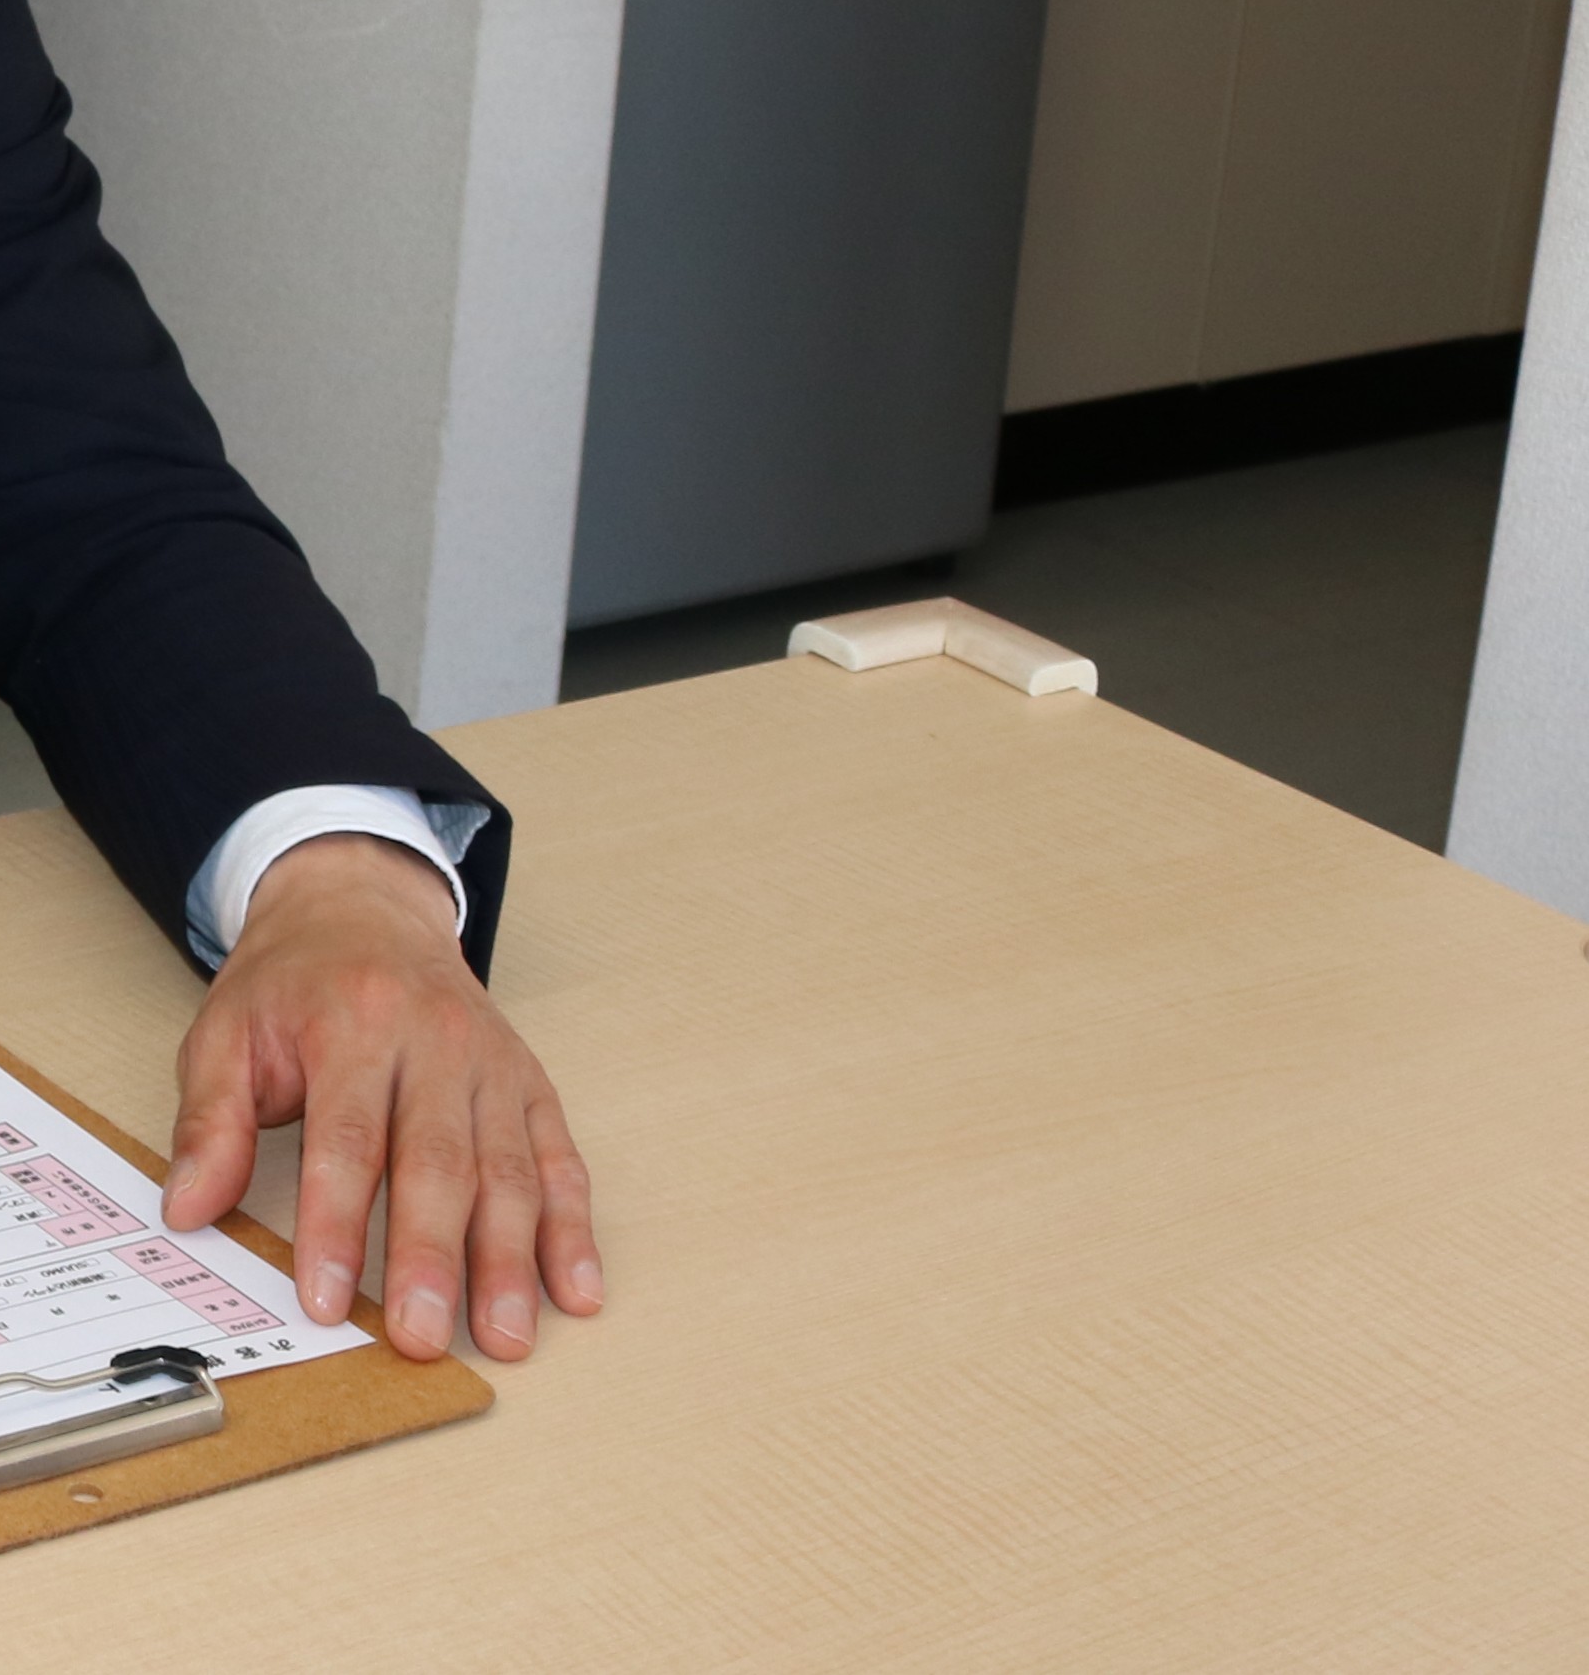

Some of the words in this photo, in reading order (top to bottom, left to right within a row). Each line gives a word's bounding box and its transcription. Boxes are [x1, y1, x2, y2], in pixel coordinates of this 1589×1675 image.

[40, 1262, 87, 1276] SUUMO
[161, 1272, 210, 1288] 生年月日
